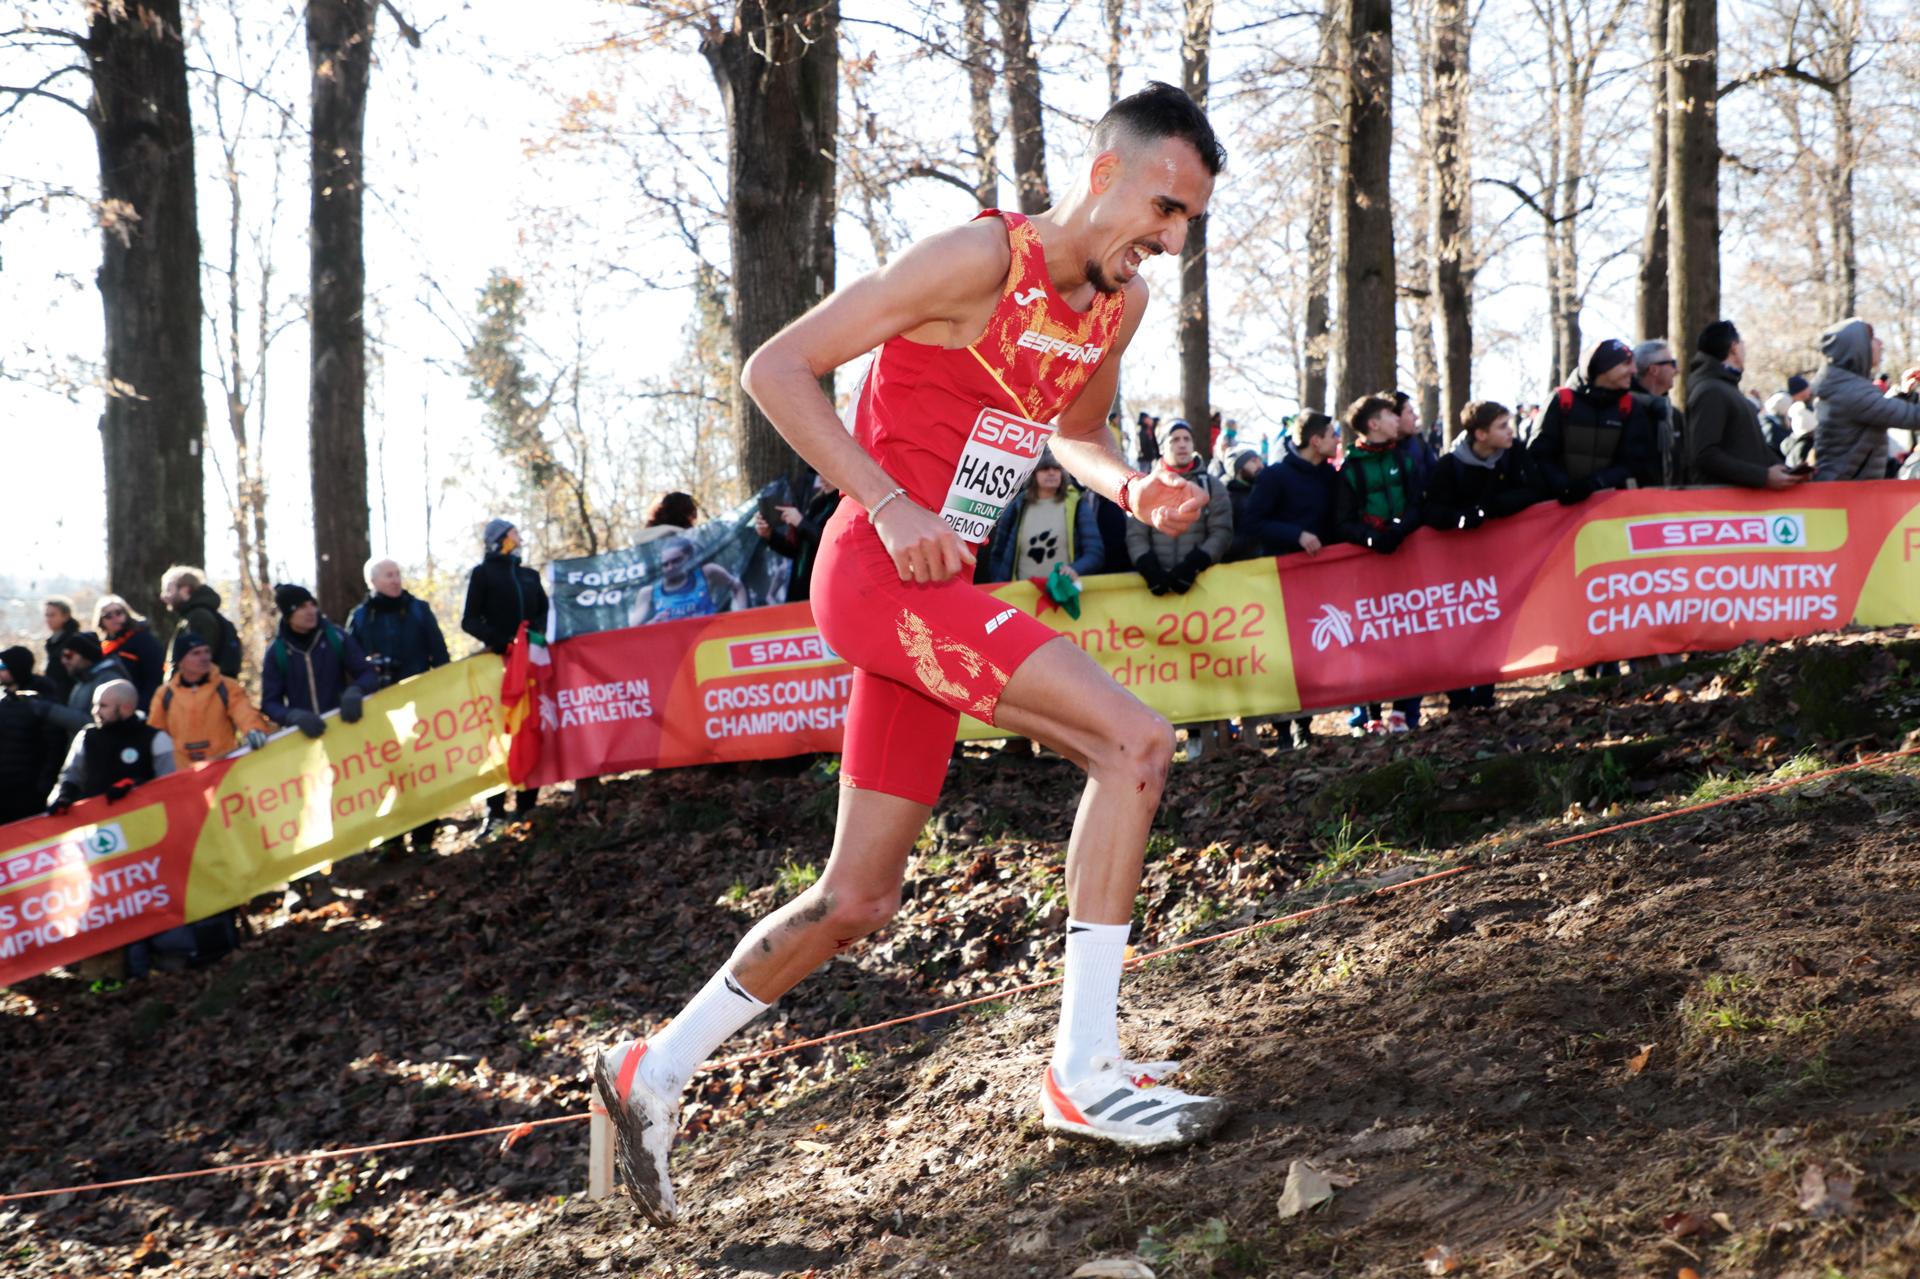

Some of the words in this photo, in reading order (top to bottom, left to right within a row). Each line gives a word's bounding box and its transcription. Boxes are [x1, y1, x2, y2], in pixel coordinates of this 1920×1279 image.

[1016, 329, 1104, 364] ESPAÑA
[968, 502, 974, 512] I
[975, 503, 996, 517] RUN
[1662, 520, 1767, 545] SPAR
[568, 562, 646, 586] Forza
[1586, 567, 1689, 602] CROSS
[1695, 564, 1837, 591] COUNTRY
[1355, 576, 1498, 621] EUROPEAN
[1587, 595, 1838, 636] CHAMPIONSHIPS
[1156, 603, 1265, 646] 2022
[1360, 598, 1501, 643] ATHLETICS
[750, 638, 821, 662] SPAR
[1189, 645, 1267, 680] Park
[557, 678, 649, 709] EUROPEAN
[704, 684, 770, 712] CROSS
[413, 696, 494, 752] 2022
[560, 699, 653, 728] ATHLETICS
[260, 820, 299, 850] La
[21, 855, 161, 921] COUNTRY
